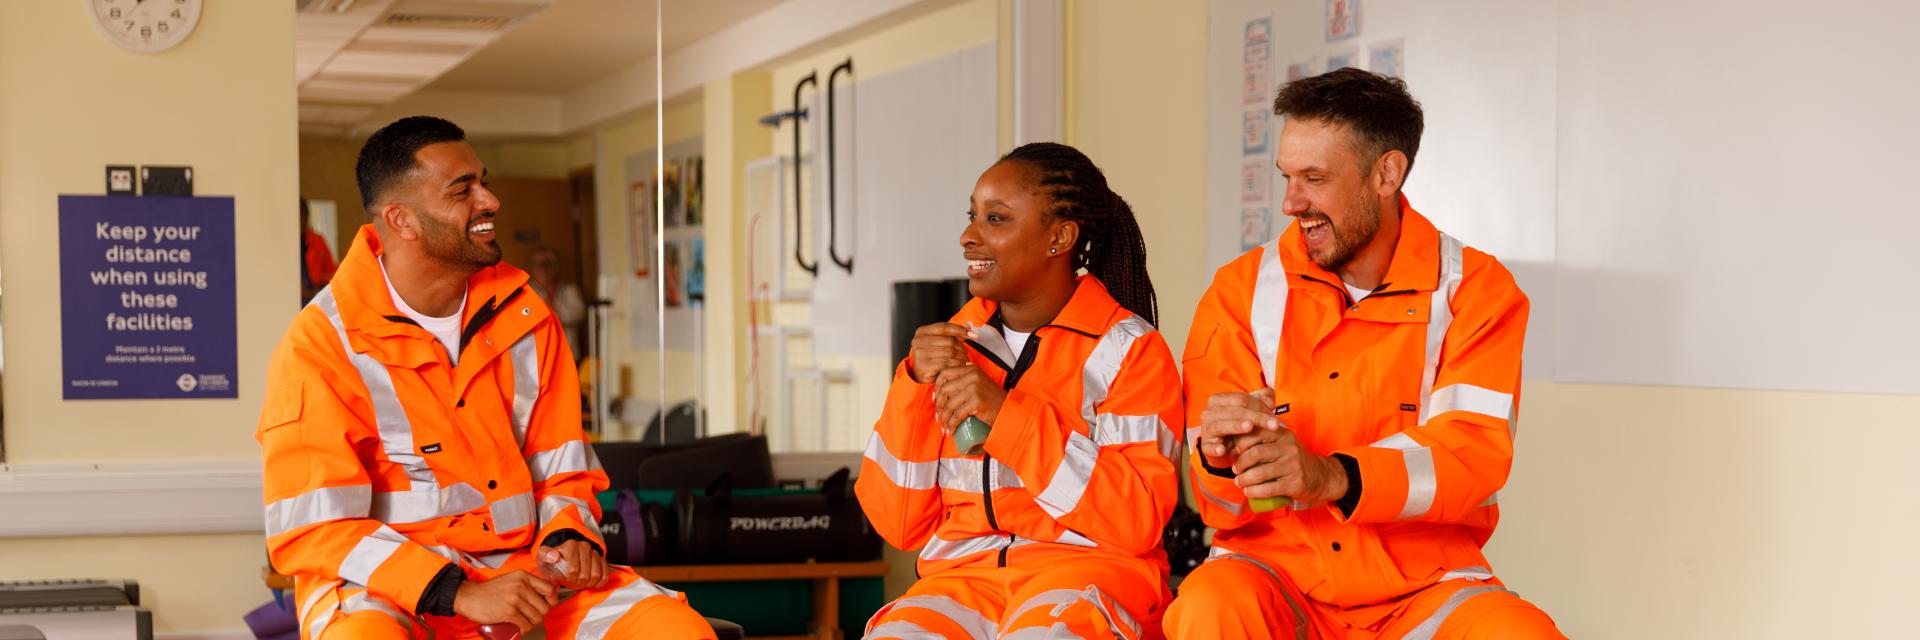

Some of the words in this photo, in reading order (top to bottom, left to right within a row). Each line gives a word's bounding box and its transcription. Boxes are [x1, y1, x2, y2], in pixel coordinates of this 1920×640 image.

[110, 7, 121, 19] 8
[170, 8, 180, 19] 4
[124, 20, 135, 31] 7
[141, 26, 152, 37] 6
[158, 21, 169, 32] 5
[96, 222, 147, 243] Keep
[153, 226, 200, 243] your
[105, 245, 191, 263] distance
[90, 267, 147, 285] when
[153, 268, 207, 289] using
[121, 290, 178, 308] these
[106, 312, 193, 331] facilities
[105, 355, 137, 363] distance
[139, 355, 162, 363] where
[730, 515, 831, 531] POWERBAG
